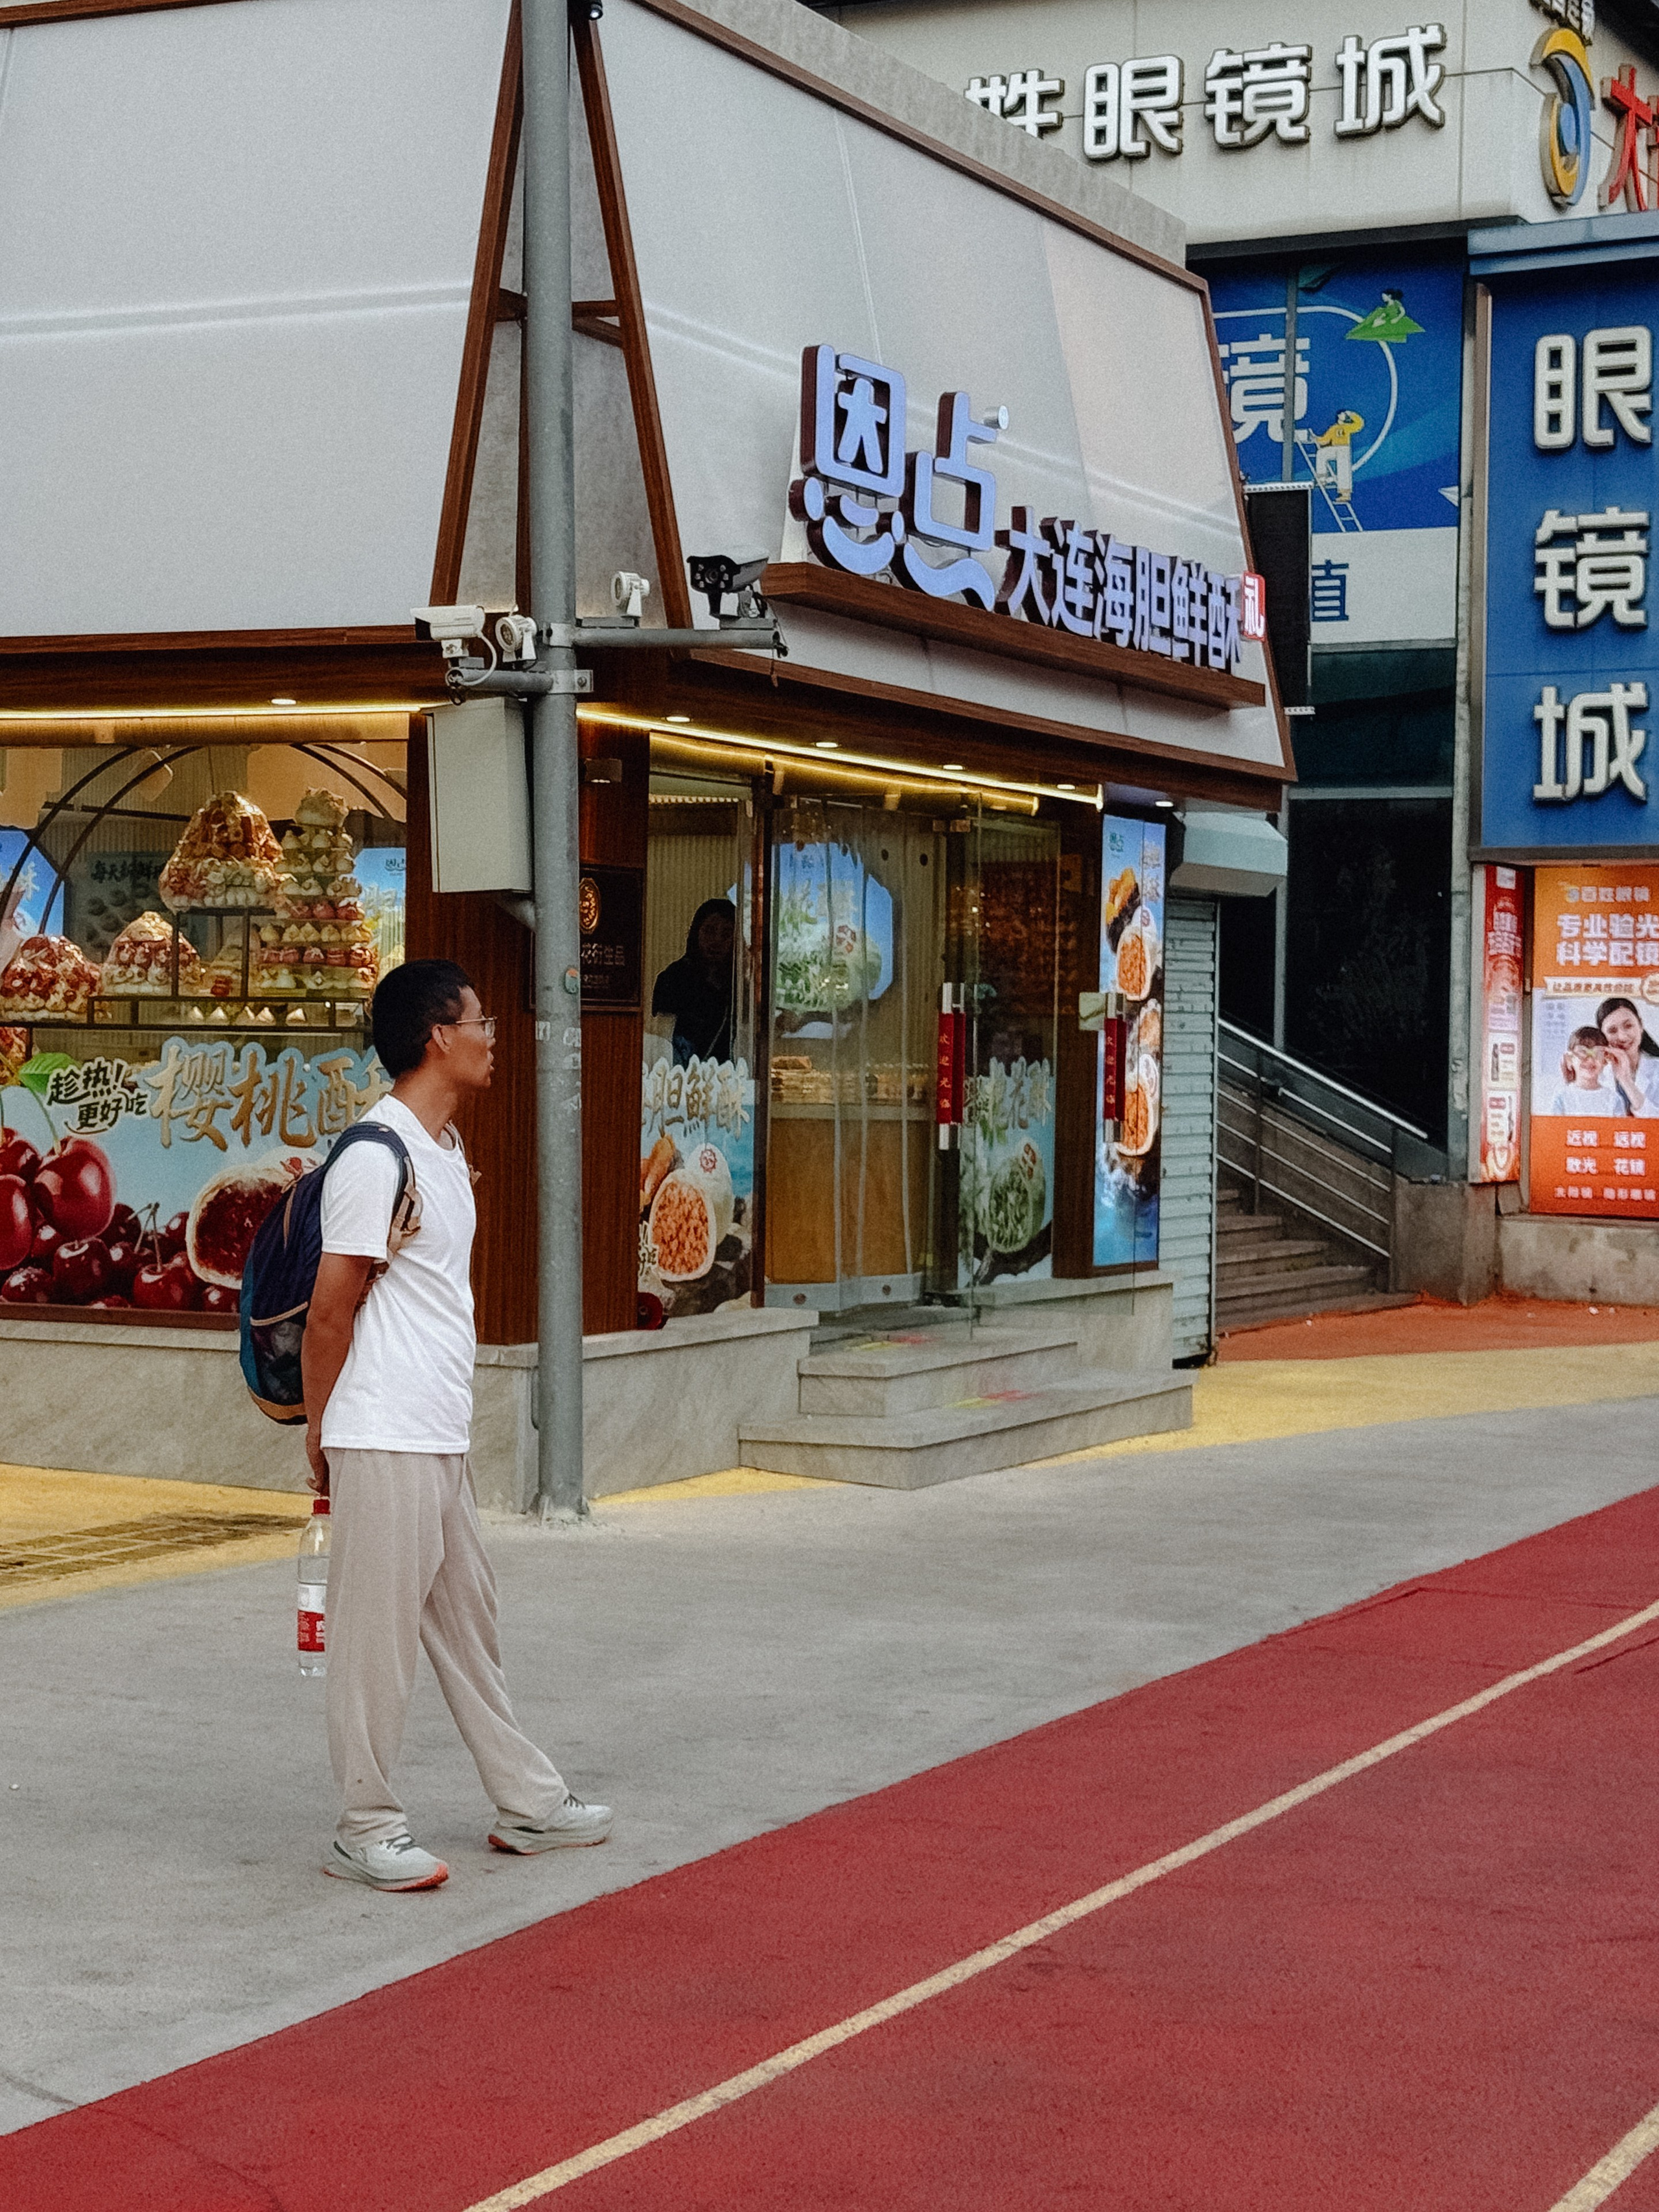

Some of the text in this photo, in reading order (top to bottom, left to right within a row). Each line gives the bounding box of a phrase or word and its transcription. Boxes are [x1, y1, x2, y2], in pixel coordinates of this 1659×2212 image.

[998, 506, 1242, 674] 大连海胆鲜酥
[1533, 325, 1653, 802] 眼镜城
[1557, 913, 1659, 939] 专业验光
[1557, 940, 1659, 966] 科学配镜
[76, 1091, 147, 1130] 更好吃
[642, 1060, 751, 1142] 胆鲜酥
